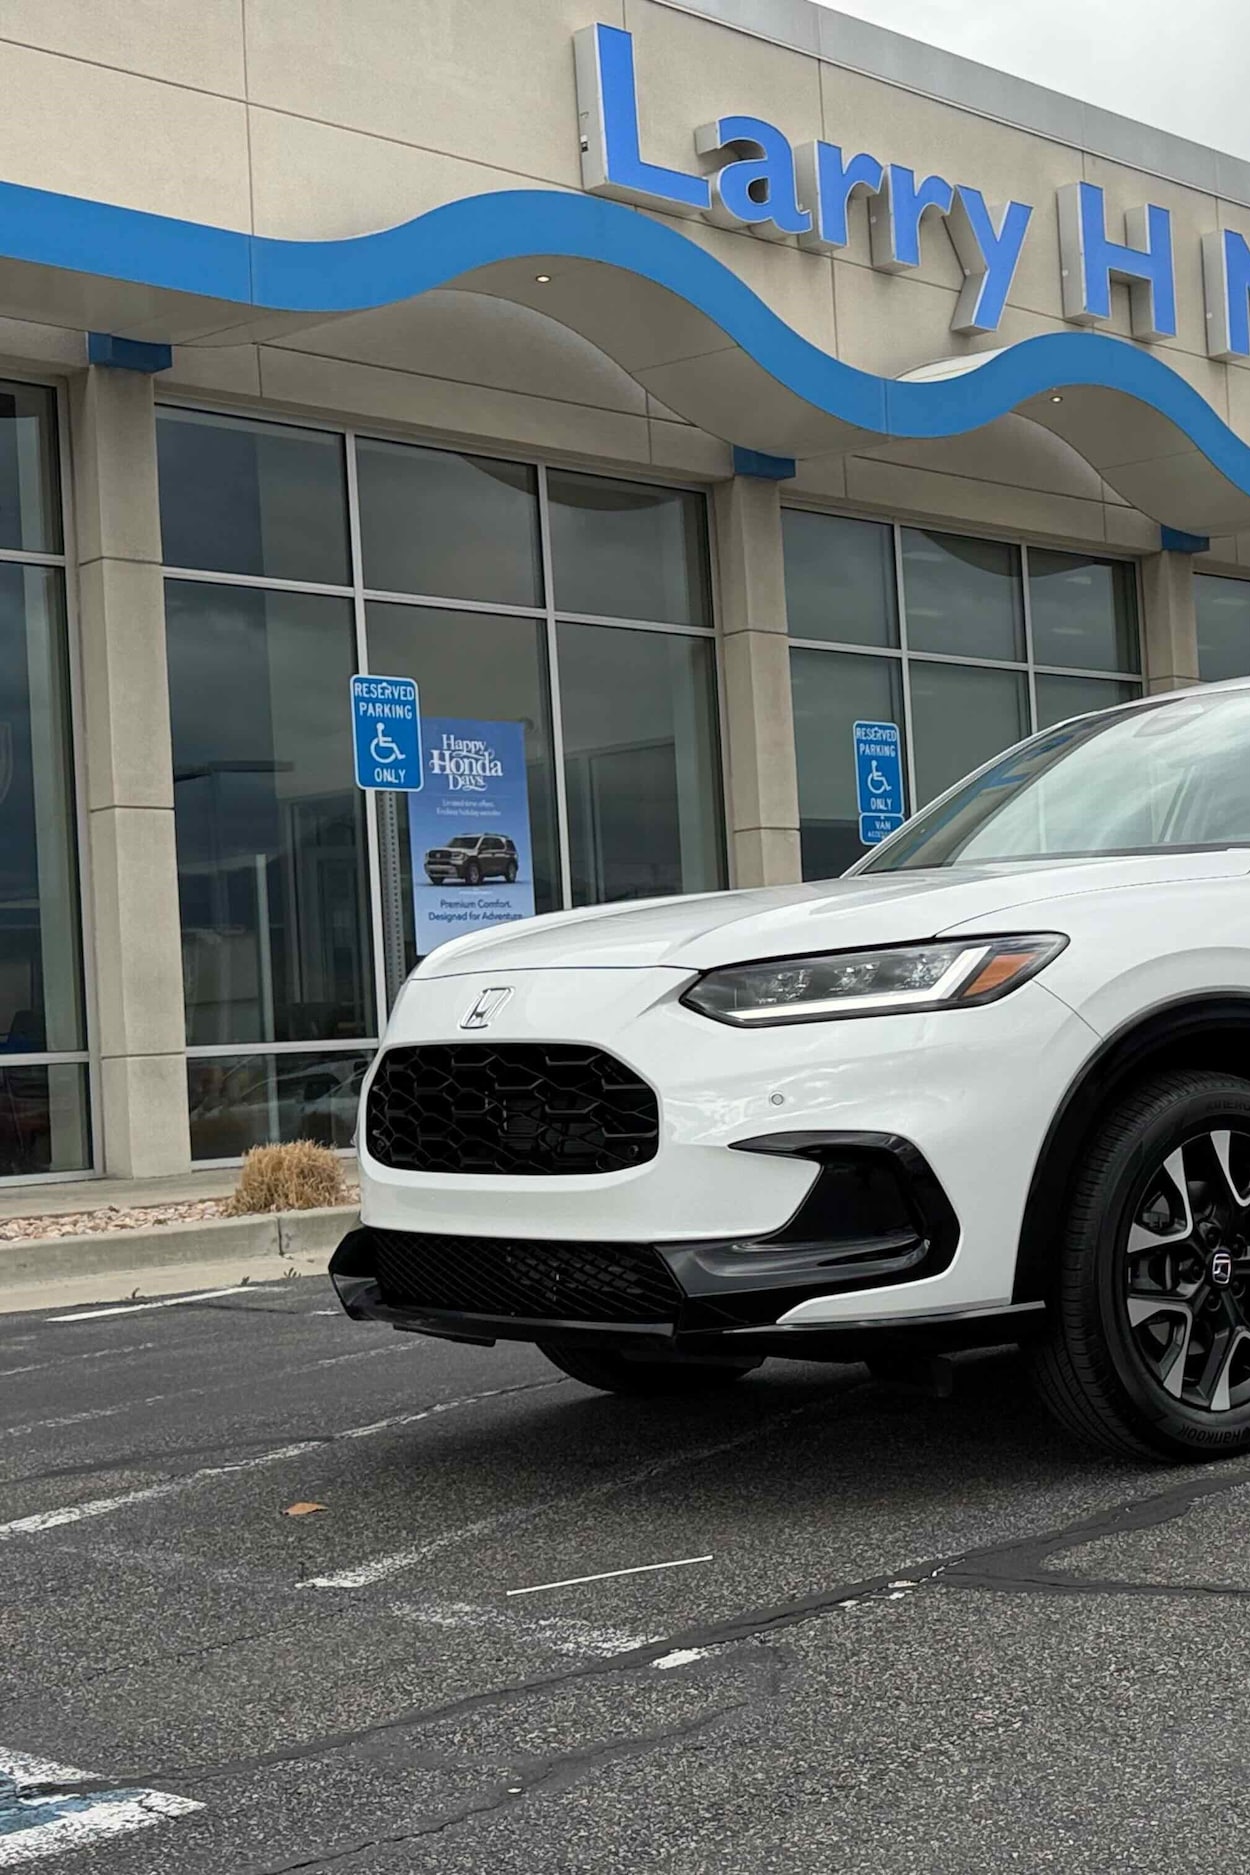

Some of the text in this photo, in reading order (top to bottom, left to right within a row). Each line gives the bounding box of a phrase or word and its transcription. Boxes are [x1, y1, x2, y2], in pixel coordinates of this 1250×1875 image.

[592, 22, 1033, 333] Larry
[1072, 181, 1177, 339] H
[354, 682, 415, 701] RESERVED
[359, 702, 413, 720] PARKING
[856, 727, 897, 742] RESERVED
[441, 734, 487, 758] Happy
[860, 743, 896, 757] PARKING
[429, 750, 503, 777] Honda
[374, 767, 406, 784] ONLY
[448, 774, 488, 792] Days
[870, 797, 893, 811] ONLY
[874, 820, 892, 831] VAN
